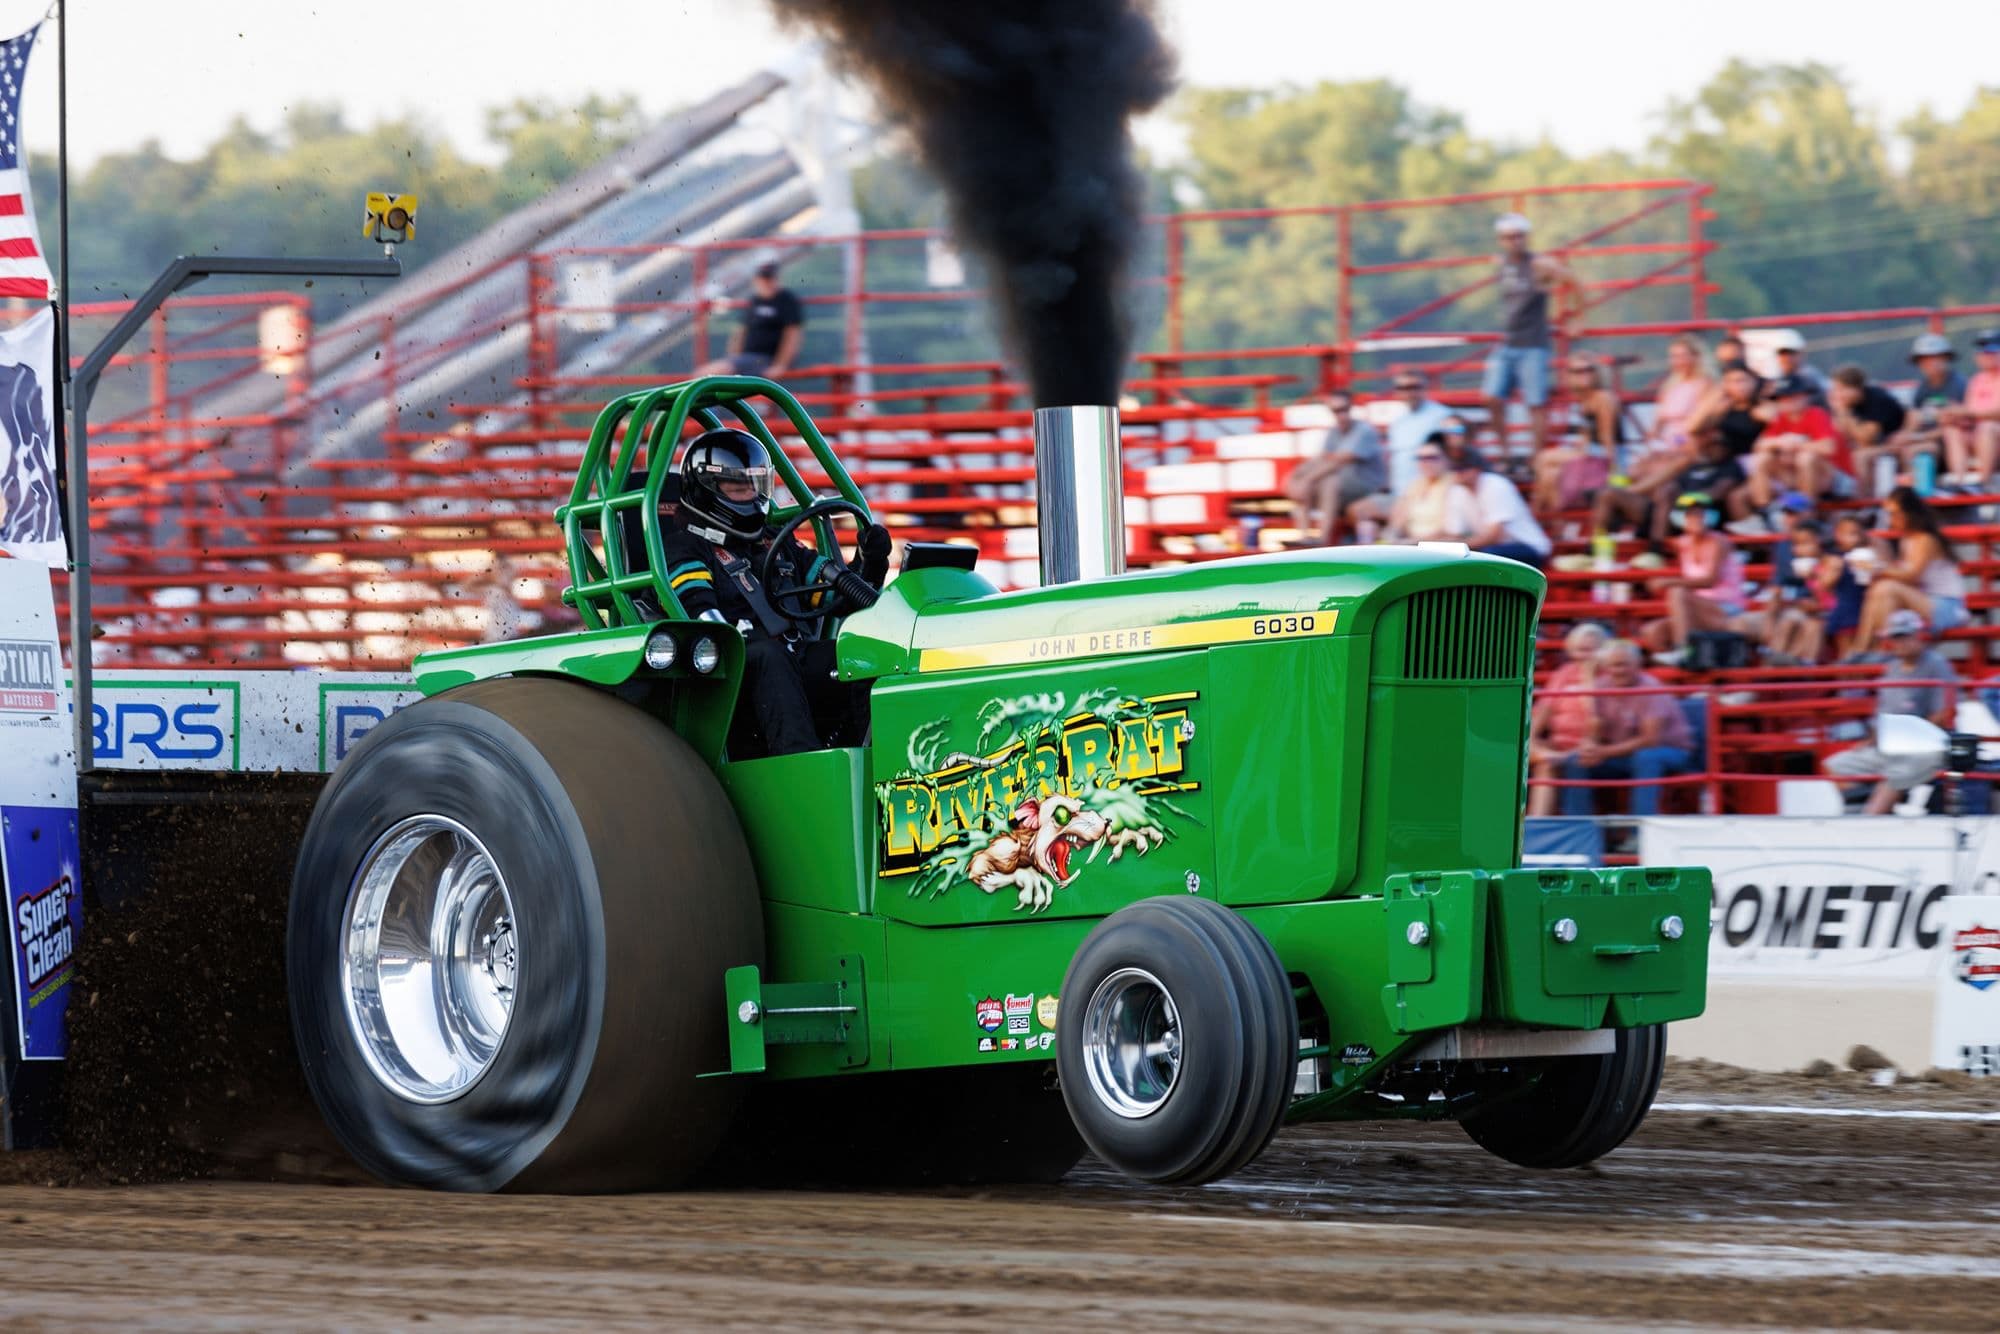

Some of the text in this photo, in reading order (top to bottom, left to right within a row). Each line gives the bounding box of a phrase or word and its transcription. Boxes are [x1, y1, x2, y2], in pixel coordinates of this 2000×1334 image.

[1028, 629, 1153, 658] JOHN DEERE
[1253, 616, 1315, 635] 6030
[3, 694, 44, 707] BATTERIES
[886, 709, 1188, 857] RIVER RAT
[18, 881, 71, 945] Super
[1711, 884, 1953, 950] OMETIC
[26, 924, 72, 984] Clean
